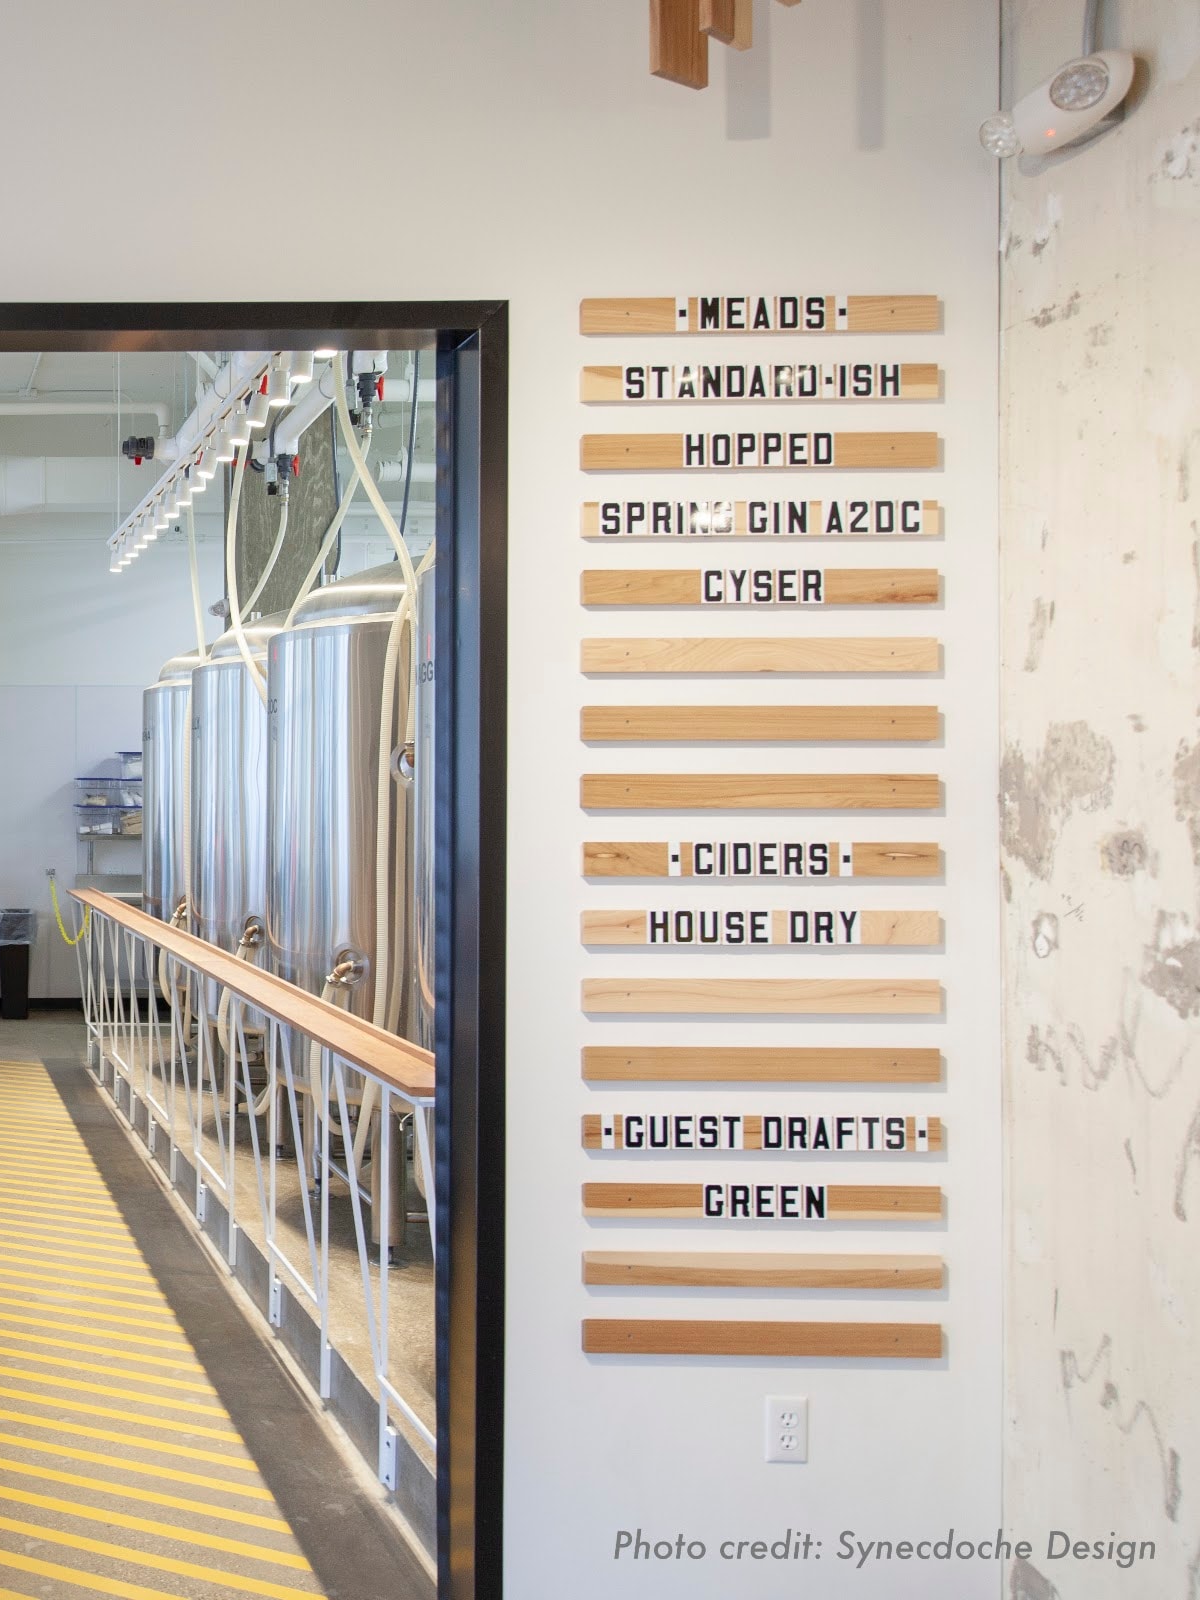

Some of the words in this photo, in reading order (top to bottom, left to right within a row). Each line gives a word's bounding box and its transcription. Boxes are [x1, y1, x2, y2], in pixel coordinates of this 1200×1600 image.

[686, 432, 832, 466] HOPPED
[749, 501, 807, 534] GIN
[826, 500, 920, 533] A2DC
[704, 569, 822, 602] CYSER
[650, 910, 769, 944] HOUSE
[790, 911, 858, 944] DRY
[625, 1115, 741, 1149] GUEST
[763, 1116, 905, 1150] DRAFTS
[705, 1184, 825, 1219] GREEN
